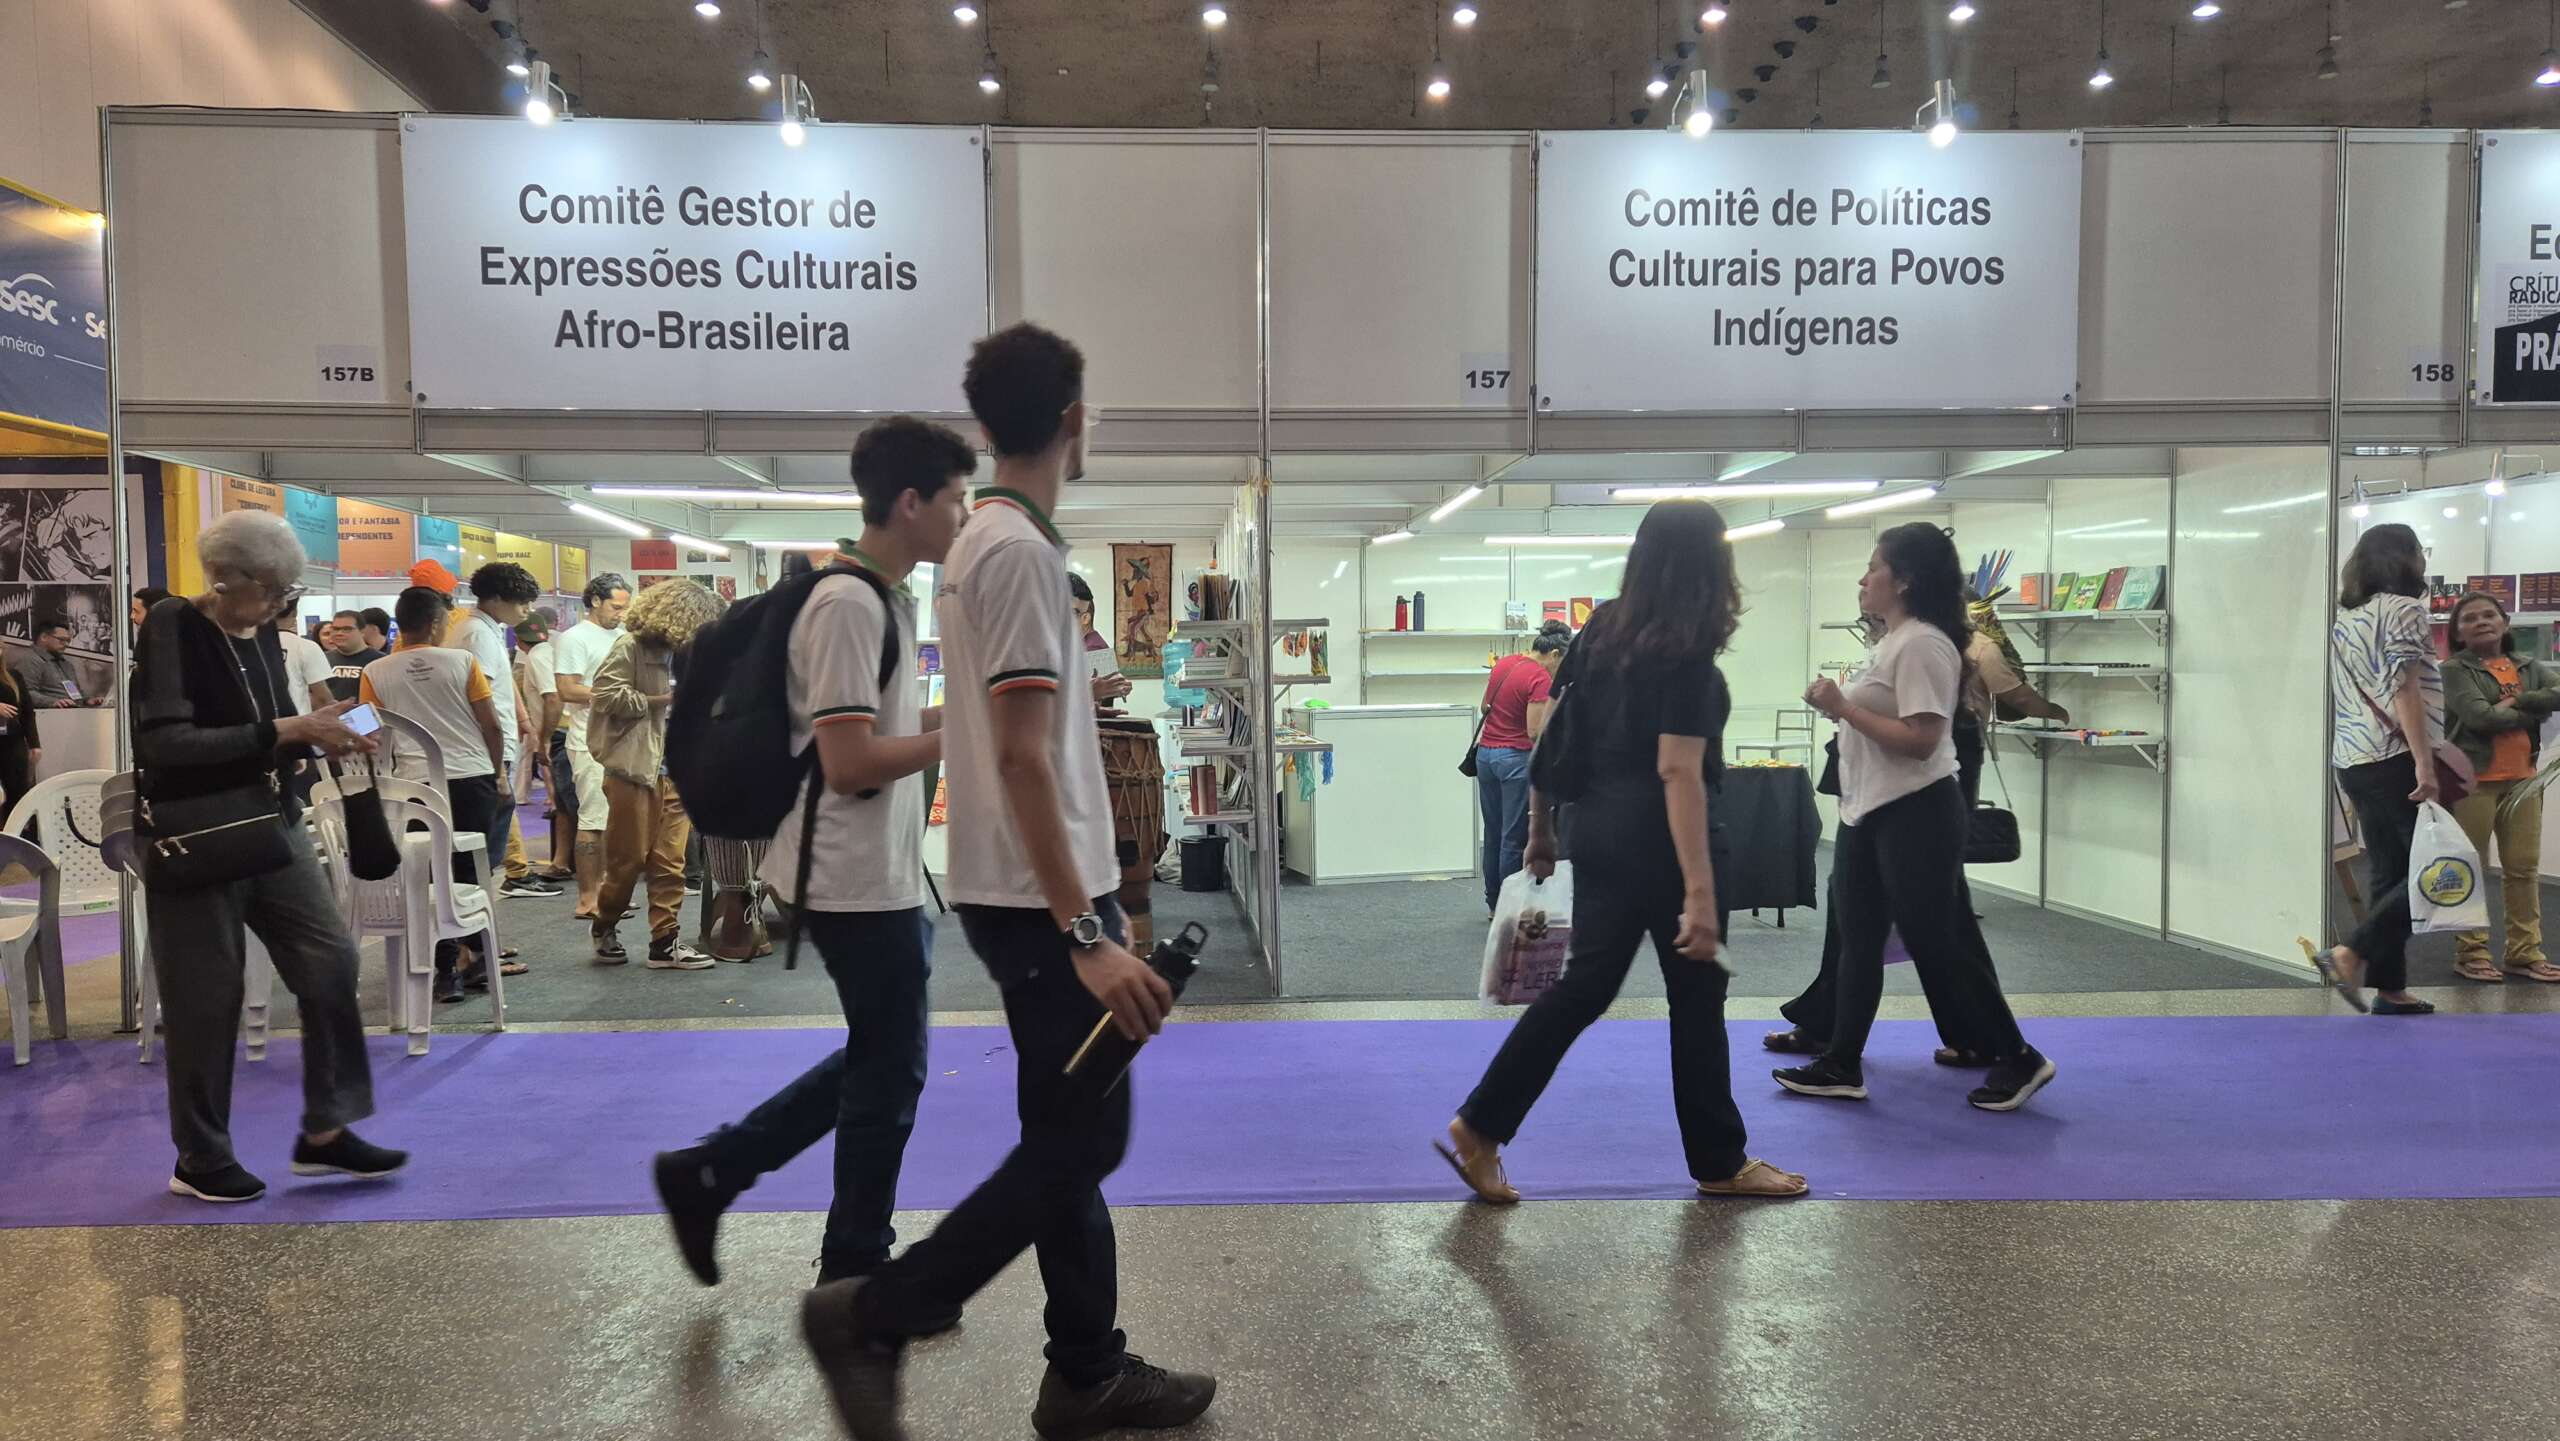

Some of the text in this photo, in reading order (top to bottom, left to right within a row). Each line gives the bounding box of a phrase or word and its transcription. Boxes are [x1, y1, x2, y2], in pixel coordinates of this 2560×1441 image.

[519, 184, 877, 230] Comitê Gestor de
[1624, 187, 1992, 228] Comitê de Políticas
[2530, 224, 2560, 260] E
[480, 246, 918, 297] Expressões Culturais
[1609, 247, 2005, 297] Culturais para Povos
[0, 335, 45, 357] mércio
[554, 310, 850, 352] Afro-Brasileira
[1713, 307, 1899, 357] Indígenas
[321, 366, 375, 382] 157B
[1465, 370, 1511, 389] 157
[2411, 363, 2455, 383] 158
[359, 517, 400, 525] FANTASIA
[333, 668, 360, 679] ANS
